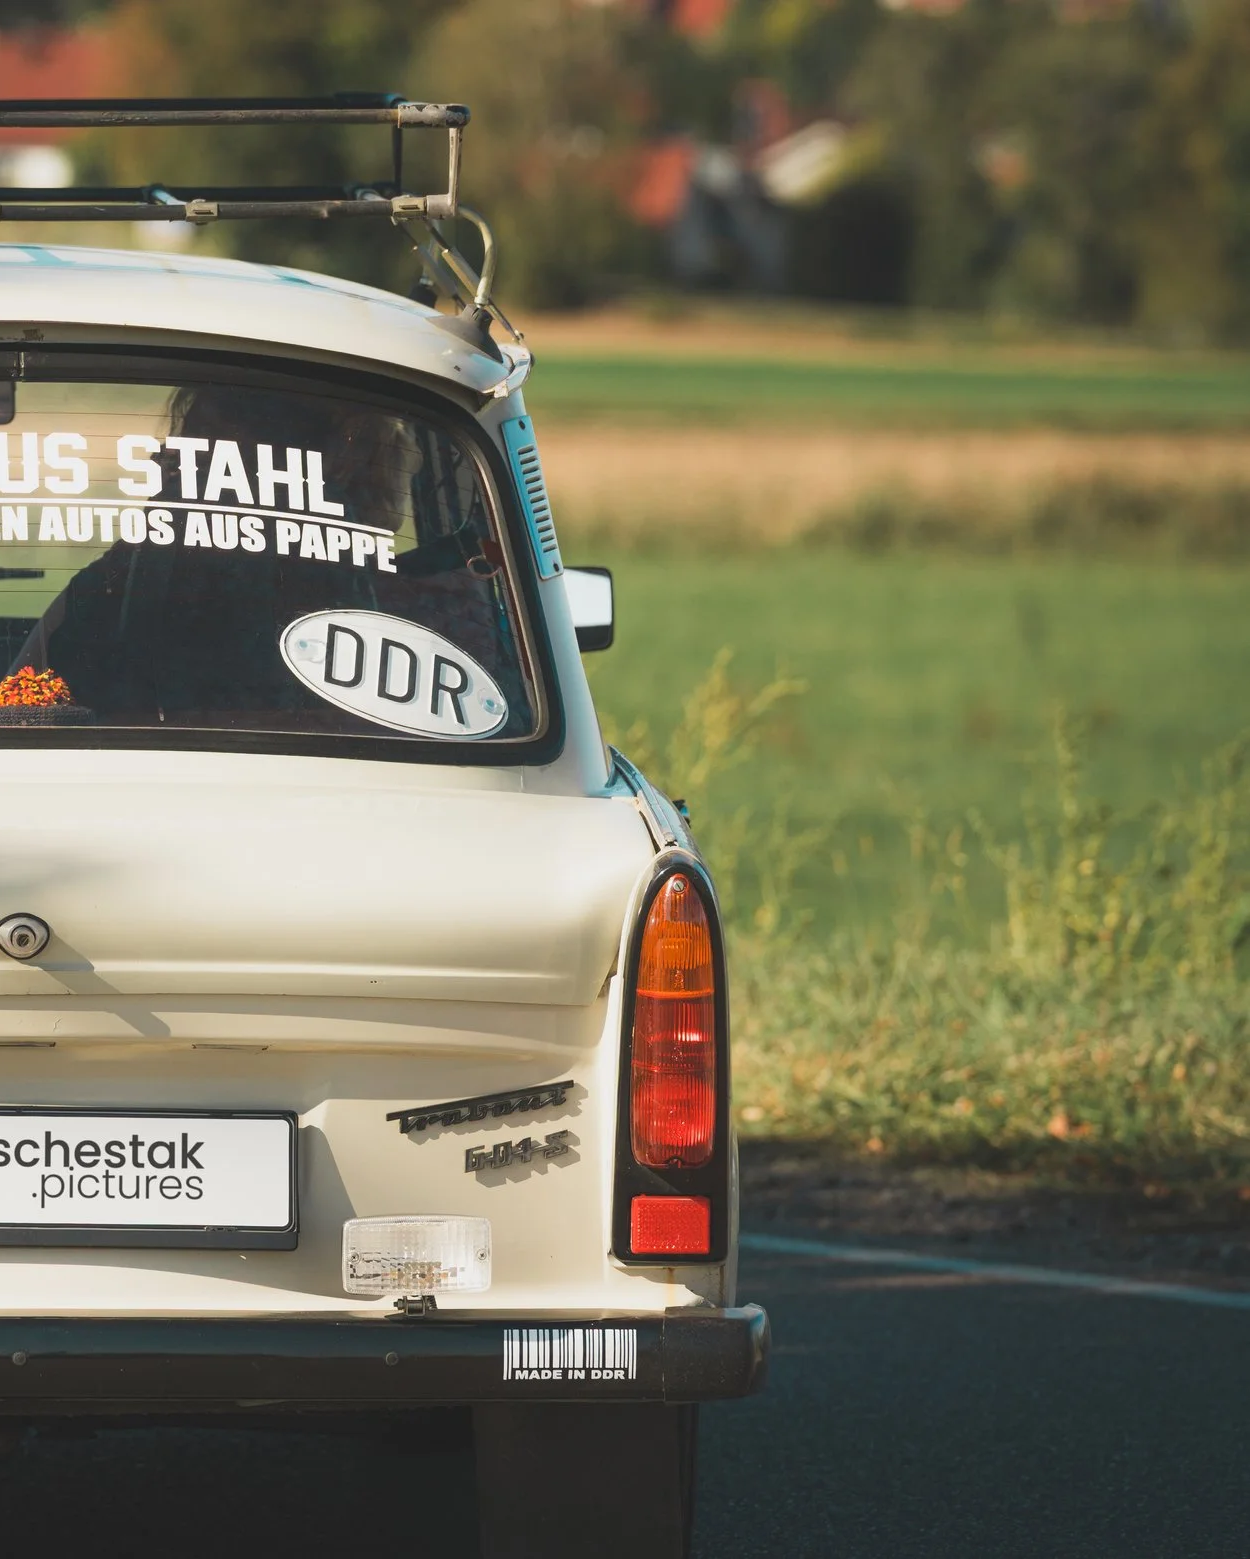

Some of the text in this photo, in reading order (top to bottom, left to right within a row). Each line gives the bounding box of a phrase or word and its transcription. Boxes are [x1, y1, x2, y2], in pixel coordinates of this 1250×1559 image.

[116, 434, 344, 517] STAHL
[37, 507, 175, 546] AUTOS
[183, 512, 267, 553] AUS
[276, 520, 397, 574] PAPPE
[324, 623, 469, 725] DDR
[386, 1080, 574, 1134] Trabant
[31, 1166, 204, 1208] .pictures
[515, 1369, 626, 1380] MADE IN DDR
